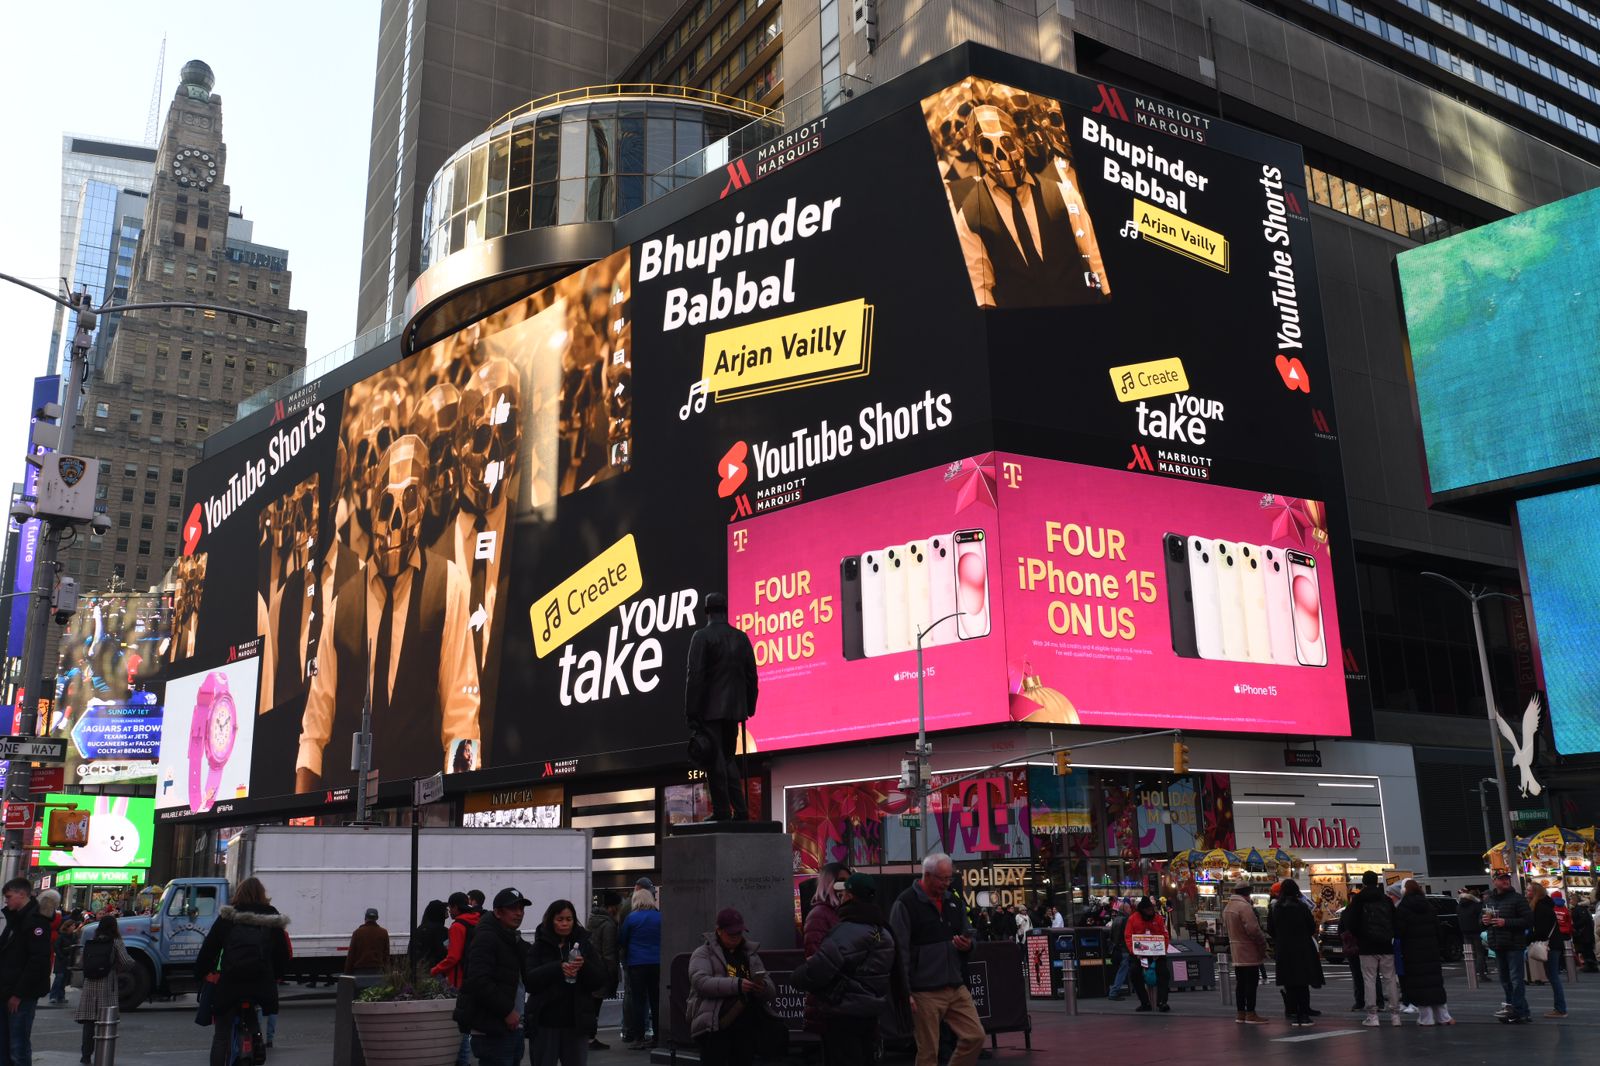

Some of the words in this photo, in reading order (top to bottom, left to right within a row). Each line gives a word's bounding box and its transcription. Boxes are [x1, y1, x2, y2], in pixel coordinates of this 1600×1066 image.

[1135, 97, 1210, 130] MARRIOTT
[1137, 111, 1205, 143] MARQUIS
[757, 137, 820, 176] MARQUIS
[758, 117, 828, 160] MARRIOTT
[1082, 116, 1208, 193] Bhupinder
[1103, 157, 1188, 215] Babbal
[1260, 165, 1290, 247] Shorts
[638, 196, 842, 283] Bhupinder
[1140, 212, 1178, 239] Arjan
[1181, 228, 1217, 254] Vailly
[662, 258, 796, 332] Babbal
[1269, 250, 1303, 350] YouTube
[713, 344, 773, 377] Arjan
[781, 325, 847, 361] Vailly
[289, 380, 322, 403] MARRIOTT
[1138, 369, 1180, 389] Create
[287, 393, 317, 414] MARQUIS
[1175, 393, 1225, 422] YOUR
[752, 420, 853, 482] YouTube
[858, 390, 953, 451] Shorts
[1135, 401, 1207, 446] take
[203, 460, 267, 535] YouTube
[268, 402, 327, 476] Shorts
[1158, 450, 1213, 467] MARRIOTT
[1159, 462, 1208, 478] MARQUIS
[757, 478, 807, 499] MARRIOTT
[757, 492, 801, 511] MARQUIS
[25, 525, 39, 563] future
[1045, 521, 1126, 561] FOUR
[567, 559, 628, 617] Create
[755, 570, 811, 605] FOUR
[1018, 557, 1119, 600] iPhone
[1125, 570, 1157, 603] 15
[618, 588, 699, 642] YOUR
[735, 606, 804, 637] iPhone
[809, 596, 833, 625] 15
[1047, 602, 1093, 637] ON
[1097, 605, 1137, 640] US
[557, 626, 663, 707] take
[753, 639, 784, 667] ON
[788, 630, 816, 660] US
[900, 668, 925, 681] iPhoe
[925, 667, 935, 677] 15
[1240, 683, 1268, 695] iPhone
[1268, 685, 1277, 696] 15
[81, 725, 122, 733] JAGUARS
[31, 744, 56, 755] WAY
[90, 765, 116, 776] CBS
[491, 790, 534, 805] INVICTA
[1141, 791, 1197, 806] HOLIDAY
[1519, 810, 1549, 820] Broadway
[1287, 817, 1361, 850] Mobile
[74, 870, 99, 880] NEW
[101, 870, 128, 880] YORK
[778, 984, 805, 994] TIM
